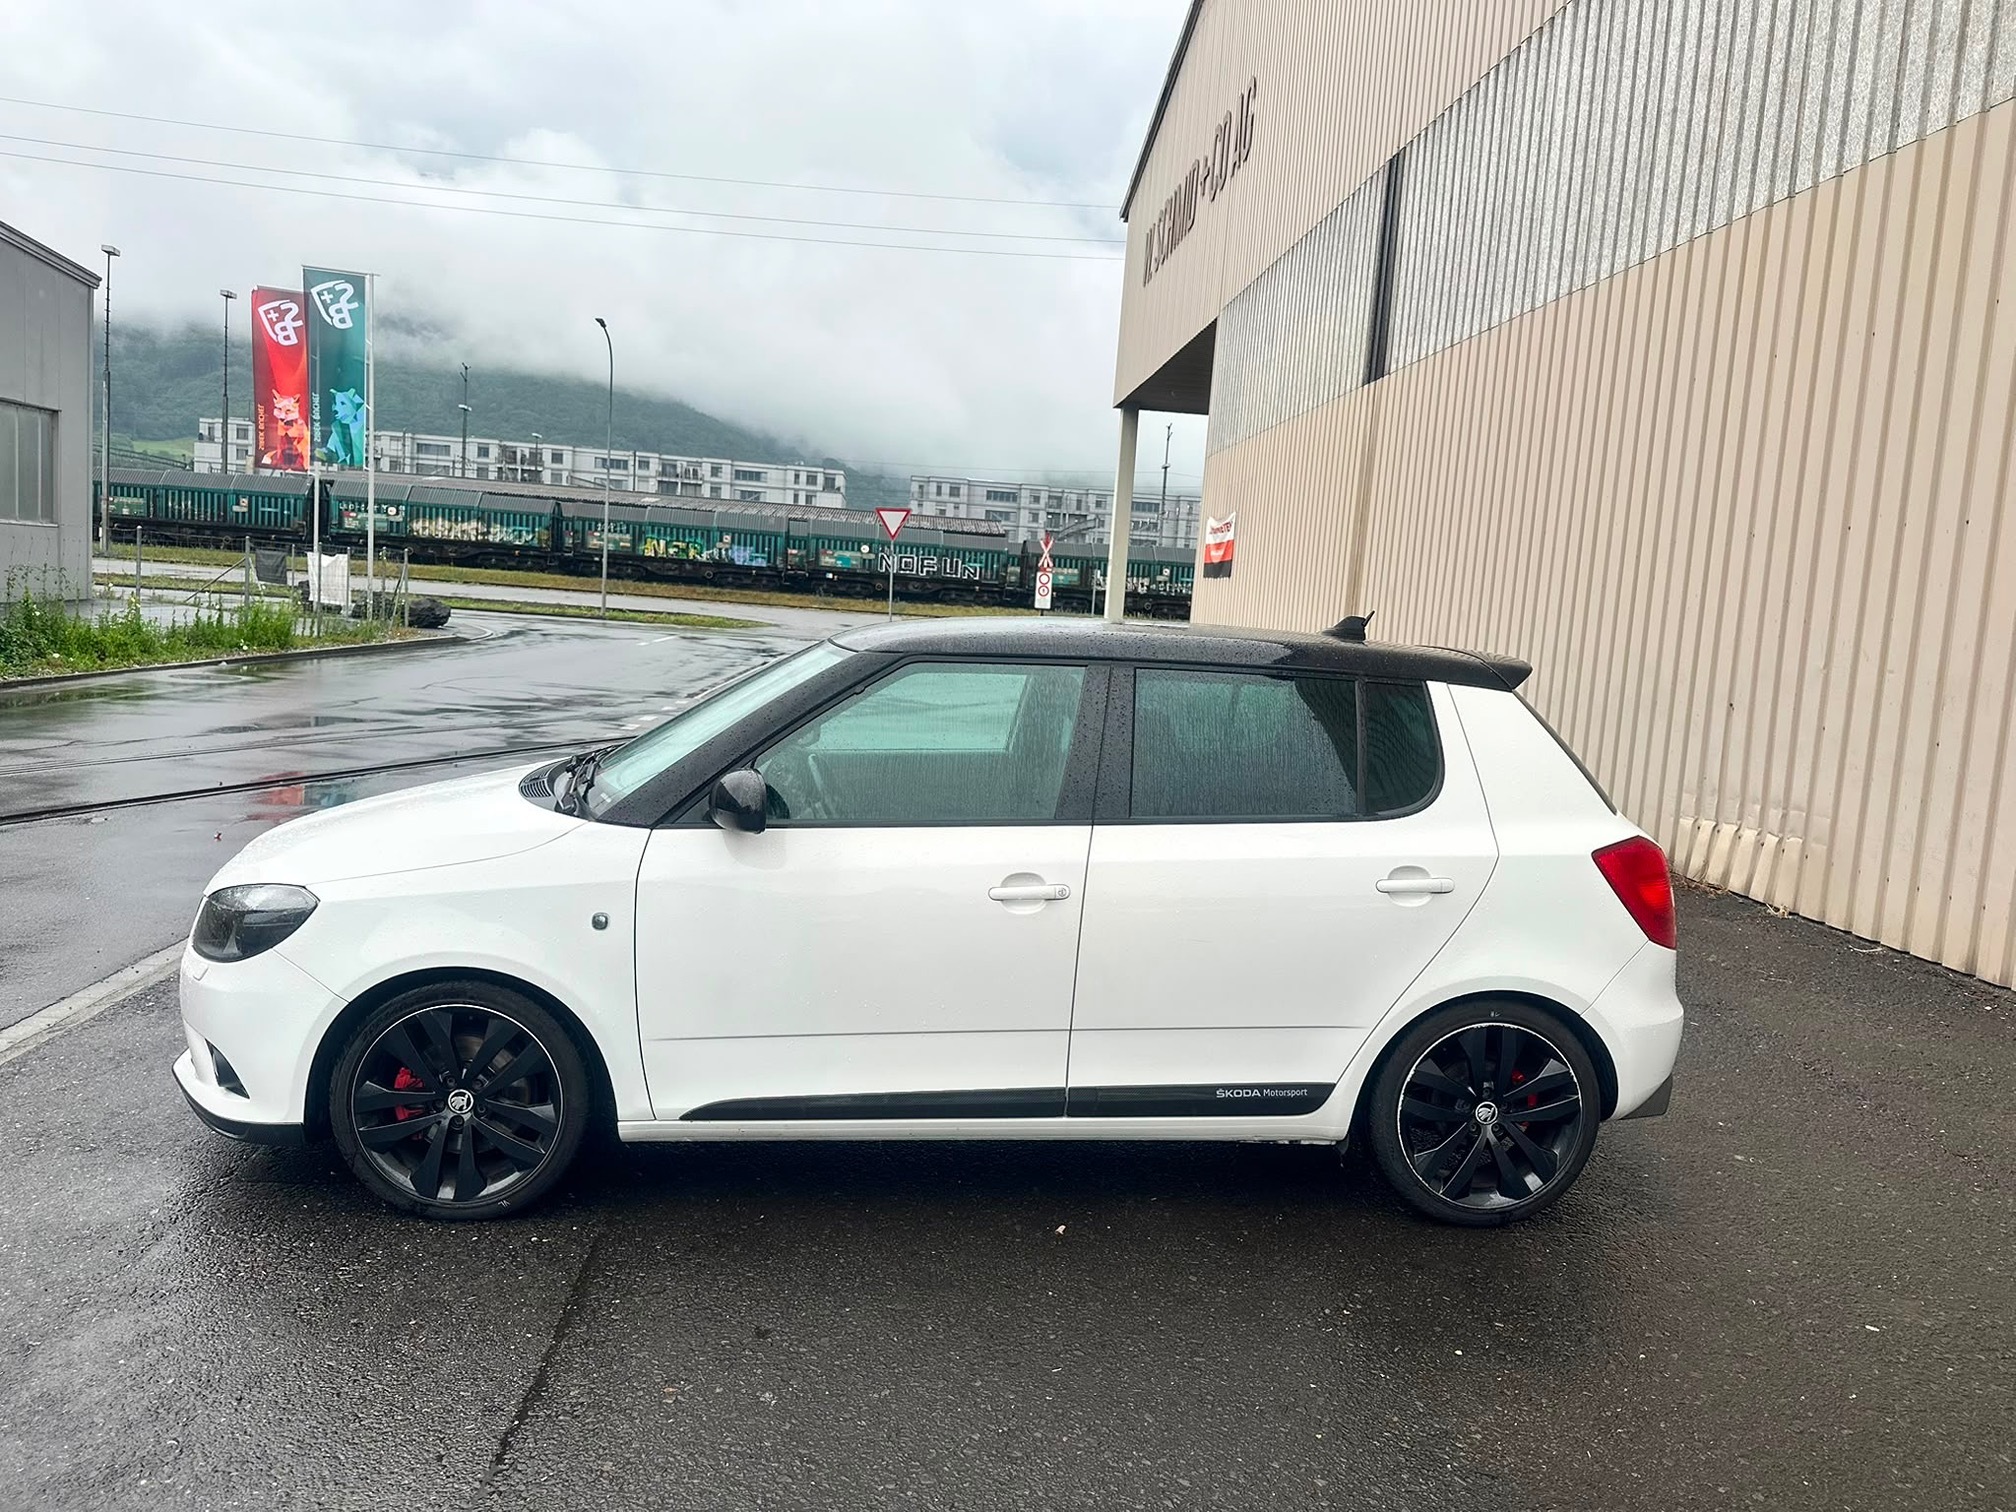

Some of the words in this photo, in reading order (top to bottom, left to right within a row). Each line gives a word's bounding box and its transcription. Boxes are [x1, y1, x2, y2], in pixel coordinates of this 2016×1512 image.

[1154, 158, 1200, 274] SCHMID
[1210, 110, 1233, 203] CO
[1231, 75, 1257, 179] AG
[1216, 1088, 1261, 1099] ŠKODA
[1263, 1088, 1308, 1098] Motorsport
